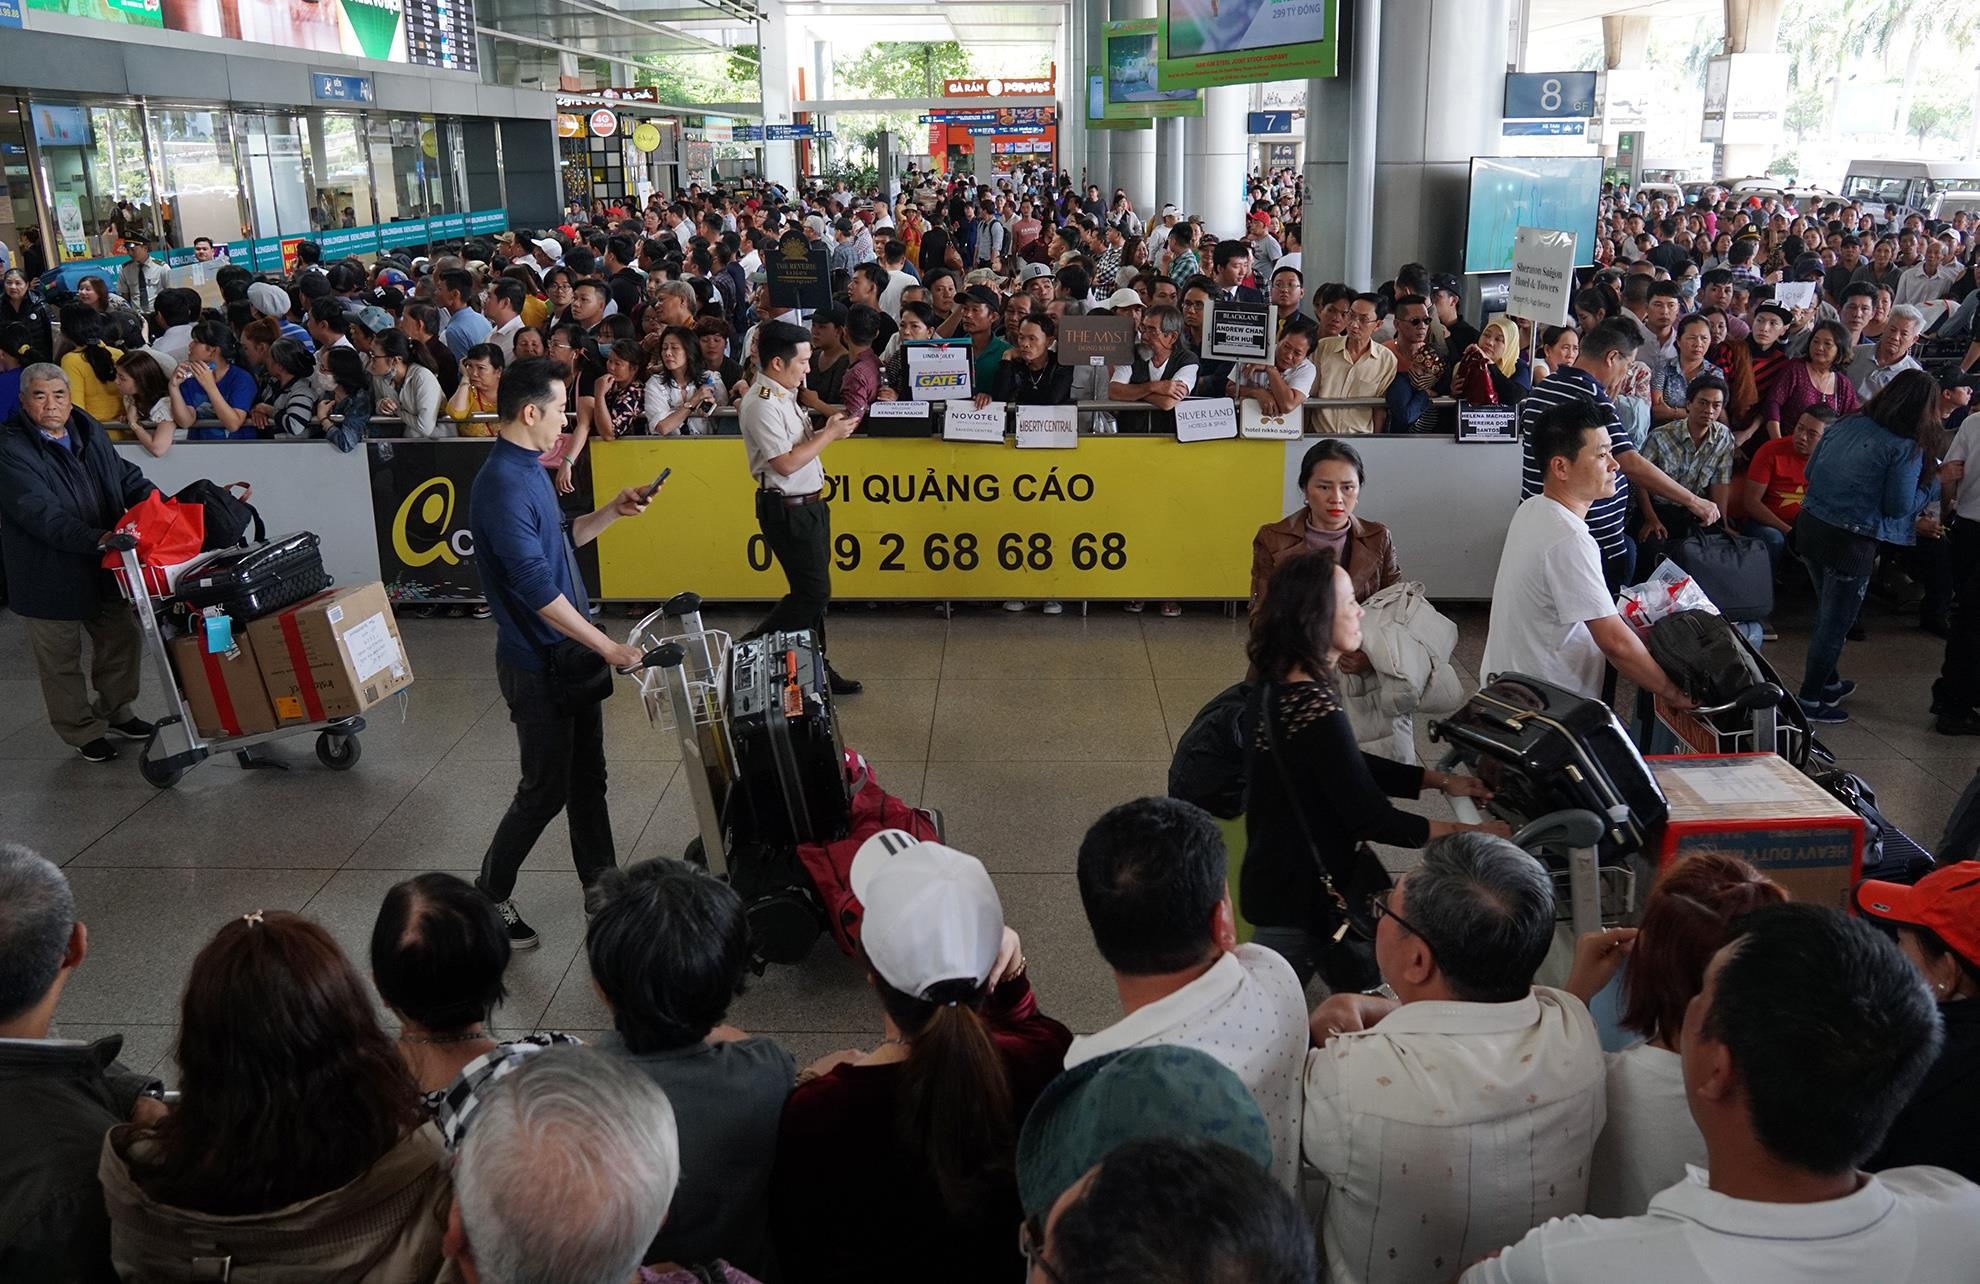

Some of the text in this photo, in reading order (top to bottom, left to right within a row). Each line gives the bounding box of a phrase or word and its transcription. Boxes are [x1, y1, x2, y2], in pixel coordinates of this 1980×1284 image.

[1272, 9, 1285, 18] 299
[1541, 79, 1561, 111] 8
[1573, 101, 1589, 111] GF
[1265, 115, 1276, 131] 7
[1516, 262, 1562, 279] Sheraton Saigon
[1515, 276, 1529, 288] Hotel
[1537, 281, 1559, 293] Towers
[1065, 329, 1128, 343] THE MYST
[952, 413, 998, 422] NOVOTEL
[1178, 408, 1233, 420] SILVER LAND
[1020, 420, 1072, 432] LIBERTY CENTRAL
[863, 467, 999, 504] QUẢNG
[1013, 466, 1094, 502] CÁO
[924, 532, 979, 571] 68
[998, 532, 1053, 571] 68
[1072, 532, 1127, 570] 68
[1750, 848, 1792, 861] DUTY
[1796, 845, 1847, 859] HEAVY
